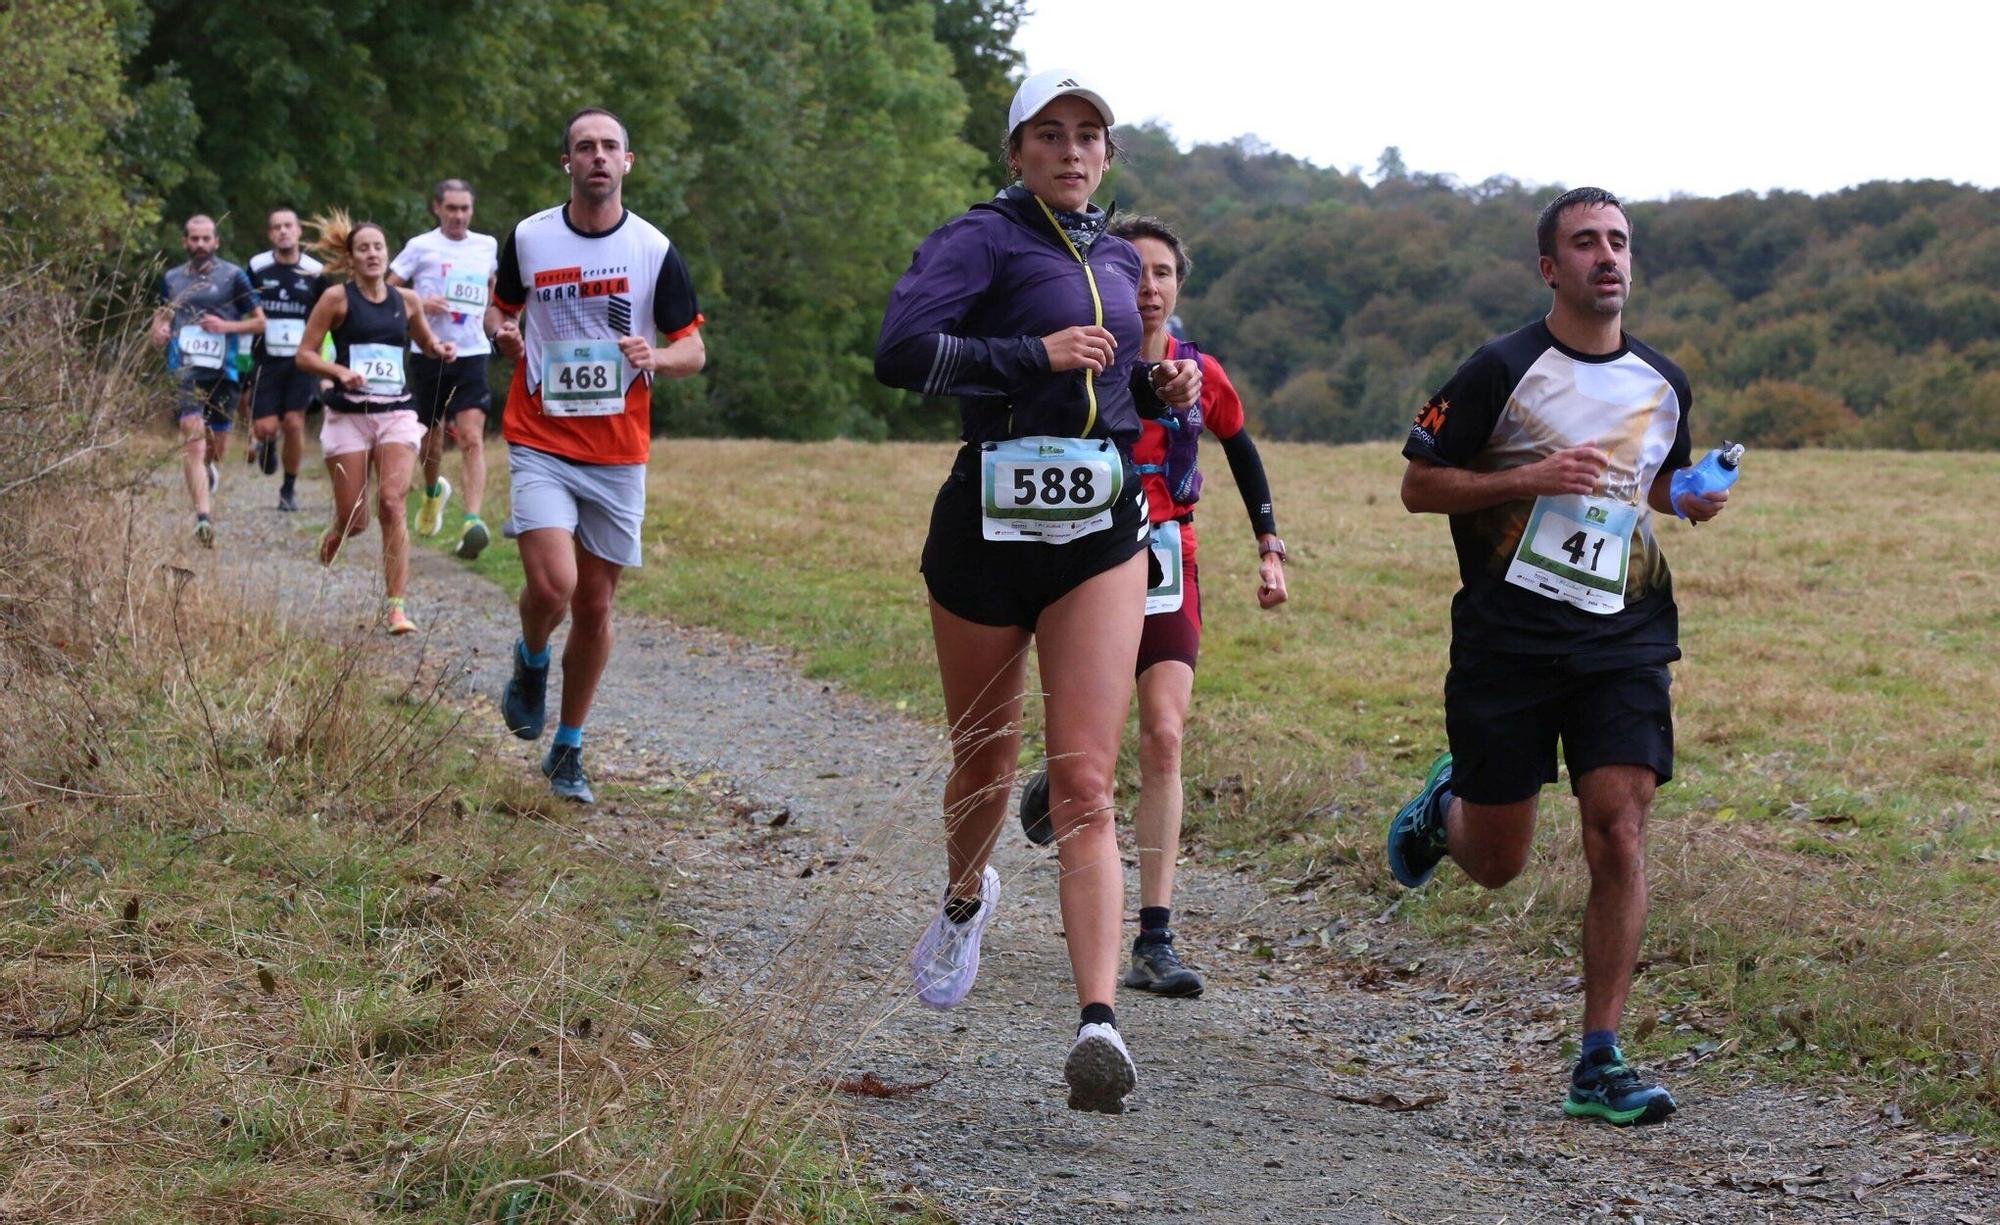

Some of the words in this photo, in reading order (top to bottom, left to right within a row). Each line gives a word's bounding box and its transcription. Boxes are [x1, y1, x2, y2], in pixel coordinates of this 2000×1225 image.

[455, 284, 480, 300] 803
[536, 279, 625, 302] IBARROLA
[364, 361, 393, 378] 762
[559, 365, 607, 390] 468
[1014, 467, 1095, 506] 588
[1561, 530, 1605, 572] 41
